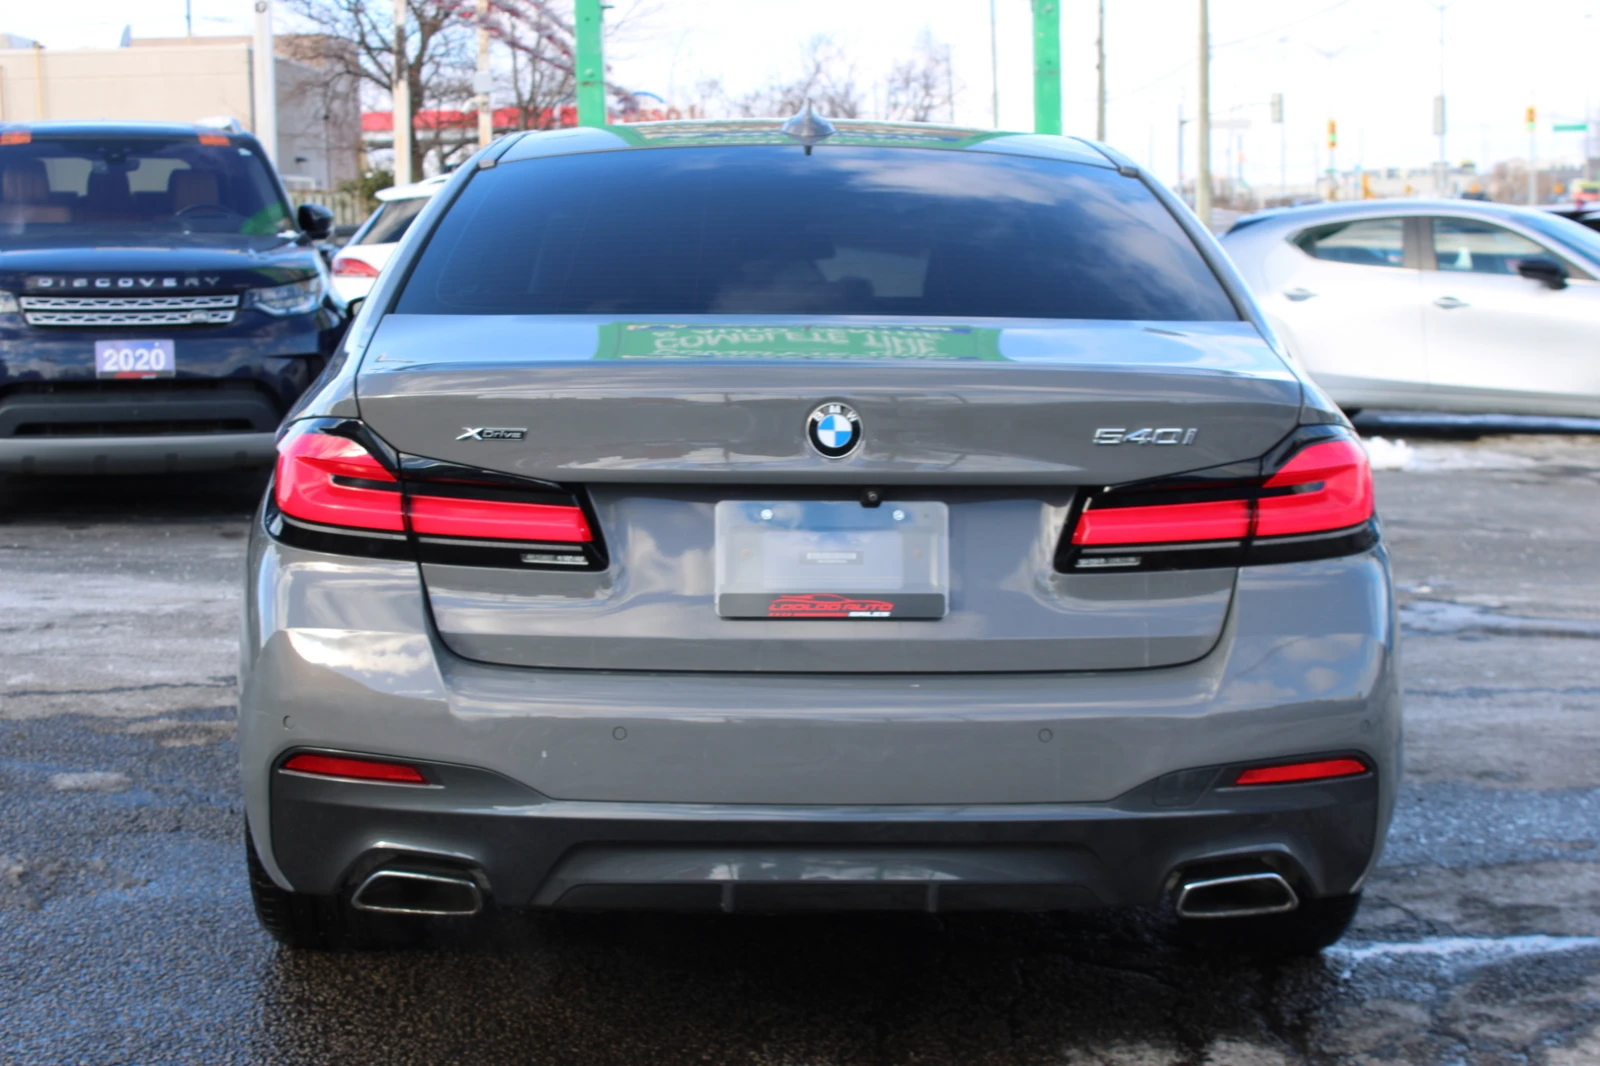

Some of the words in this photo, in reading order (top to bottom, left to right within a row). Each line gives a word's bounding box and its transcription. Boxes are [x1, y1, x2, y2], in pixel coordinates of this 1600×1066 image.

[37, 276, 221, 288] DISCOVERY
[103, 348, 166, 371] 2020
[812, 404, 859, 422] BMW
[1092, 428, 1198, 445] 540i
[842, 603, 894, 611] AUTO
